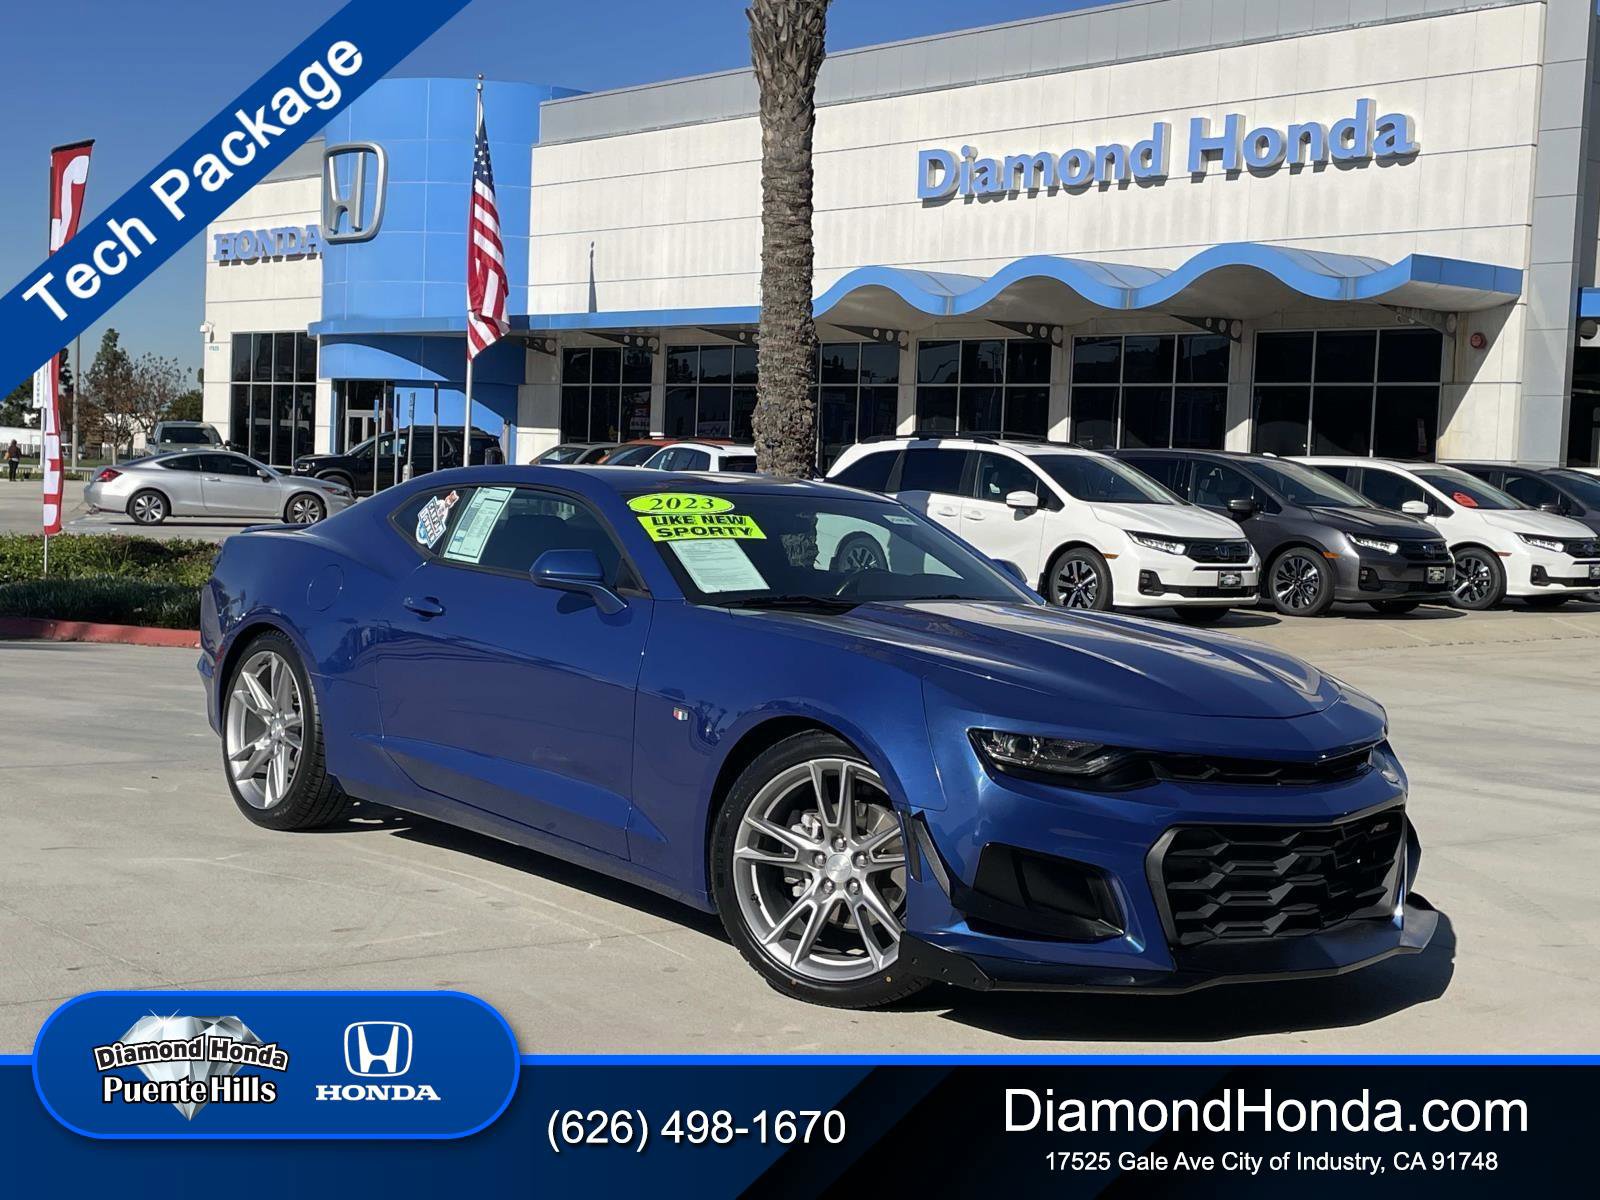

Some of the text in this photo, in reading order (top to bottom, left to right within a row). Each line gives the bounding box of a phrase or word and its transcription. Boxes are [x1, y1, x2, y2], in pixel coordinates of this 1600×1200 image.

[916, 97, 1419, 202] Diamond Honda
[213, 224, 322, 261] HONDA
[649, 497, 715, 511] 2023
[650, 515, 747, 526] LIKE NEW
[655, 526, 754, 538] SPORTY
